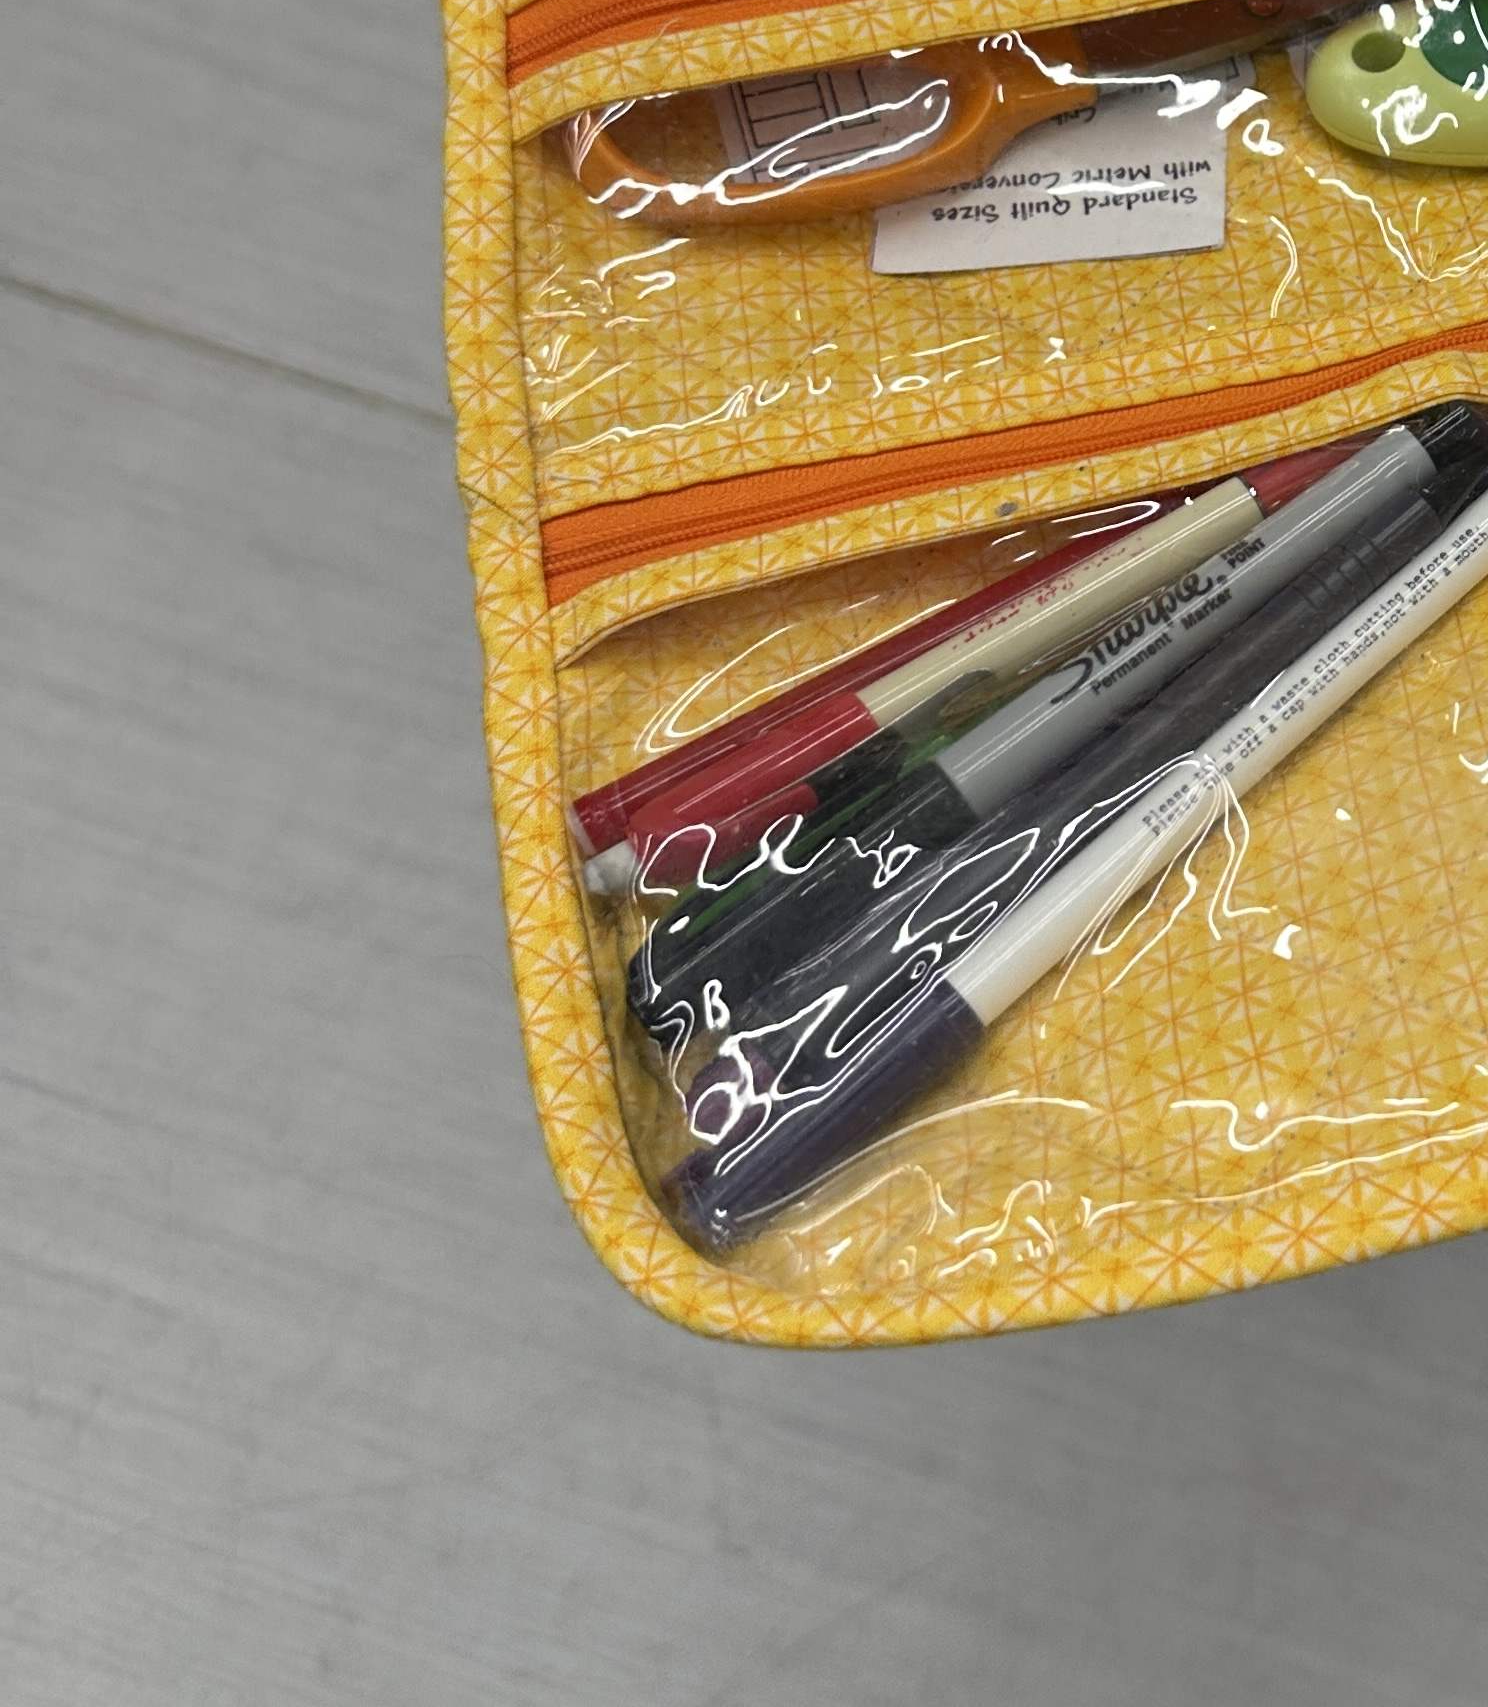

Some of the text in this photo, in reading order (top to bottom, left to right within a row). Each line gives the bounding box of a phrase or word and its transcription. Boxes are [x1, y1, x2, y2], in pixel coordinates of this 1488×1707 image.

[932, 185, 1197, 223] Standard Quilt Sizes
[1162, 161, 1211, 181] with
[1226, 536, 1265, 569] POINT
[1050, 571, 1213, 702] Sharpie
[1088, 630, 1172, 696] Permanent
[1180, 587, 1234, 631] Marker
[1141, 782, 1191, 828] Please
[1221, 723, 1255, 756] with
[1270, 674, 1310, 713] waste
[1310, 637, 1351, 675] cloth
[1351, 589, 1405, 639] cutting
[1403, 548, 1449, 591] before
[1450, 521, 1481, 549] use.
[1237, 733, 1263, 759] off
[1279, 696, 1308, 722] cap
[1306, 664, 1341, 697] with
[1407, 575, 1440, 606] with
